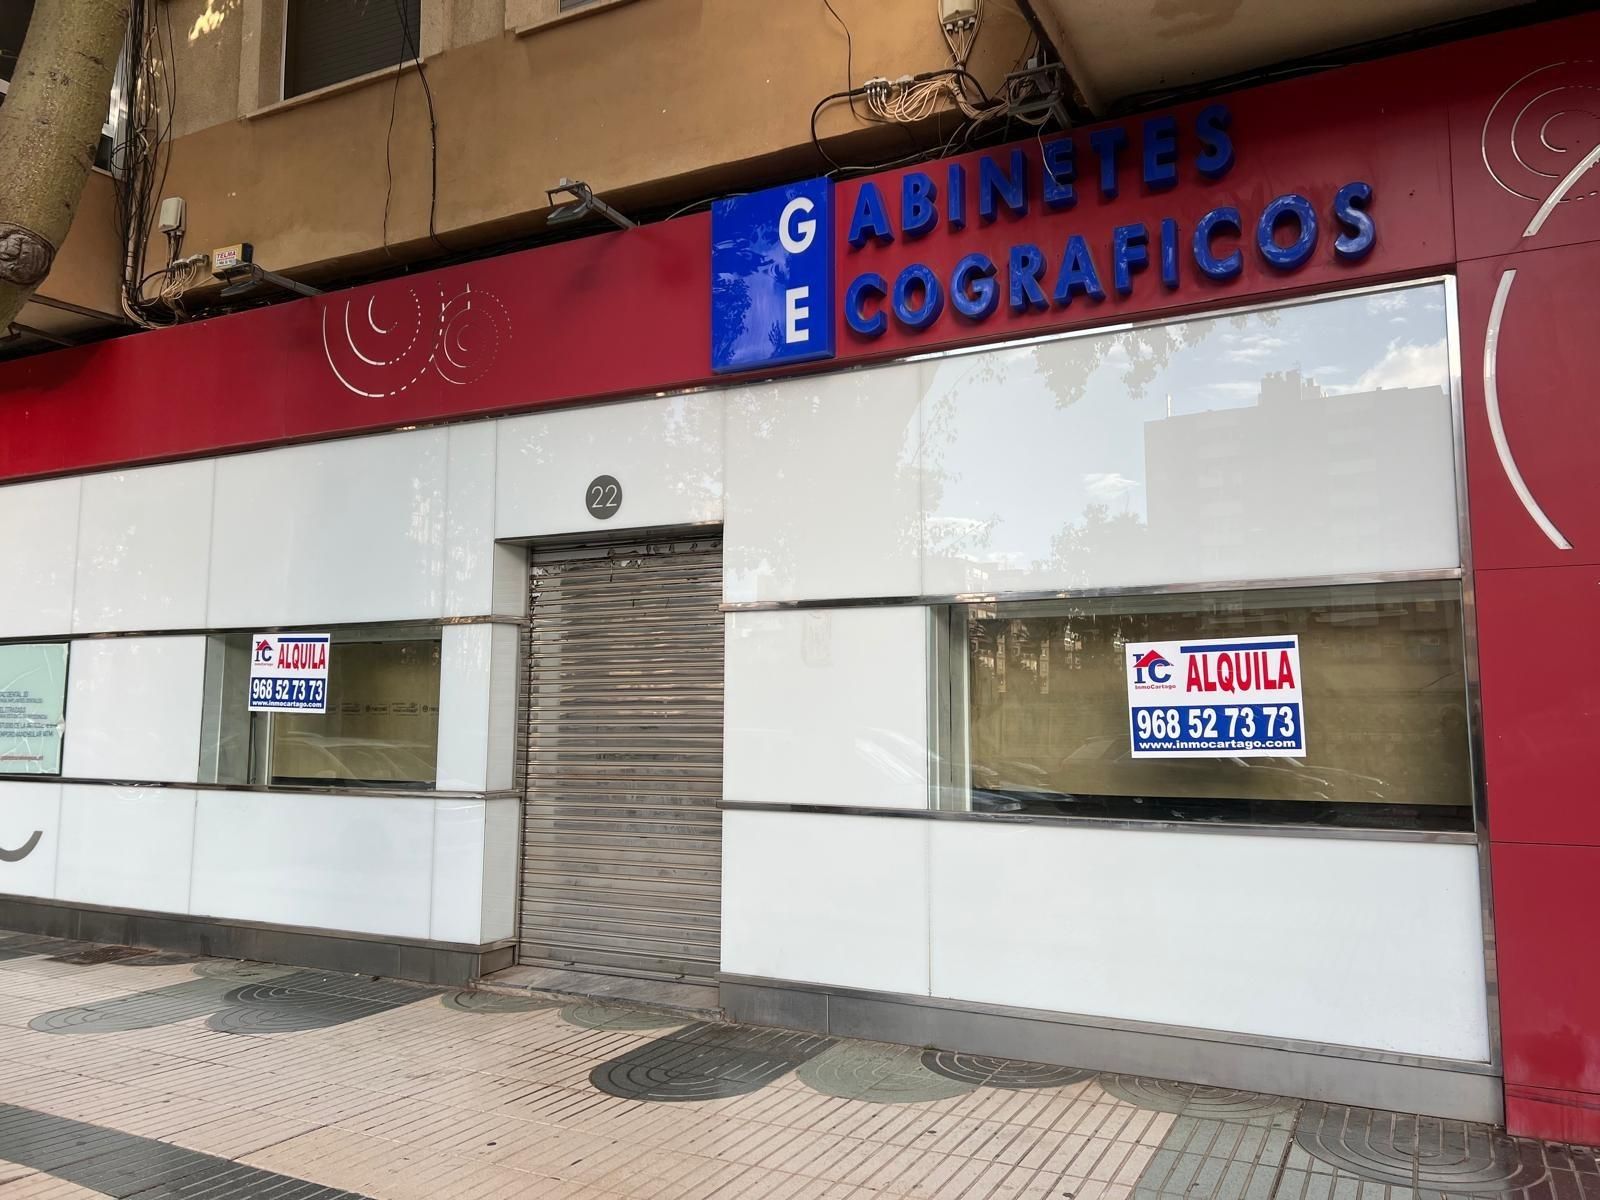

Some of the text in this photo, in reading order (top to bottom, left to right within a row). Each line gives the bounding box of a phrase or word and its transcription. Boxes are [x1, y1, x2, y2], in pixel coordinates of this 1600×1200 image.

[591, 484, 617, 508] 22
[277, 643, 326, 670] ALQUILA
[1186, 650, 1296, 694] ALQUILA
[252, 679, 323, 701] 968 52 73 73
[252, 700, 322, 708] www.inmocartago.com
[1136, 705, 1295, 739] 968 52 73 73
[1139, 738, 1296, 750] www.inmocartago.com
